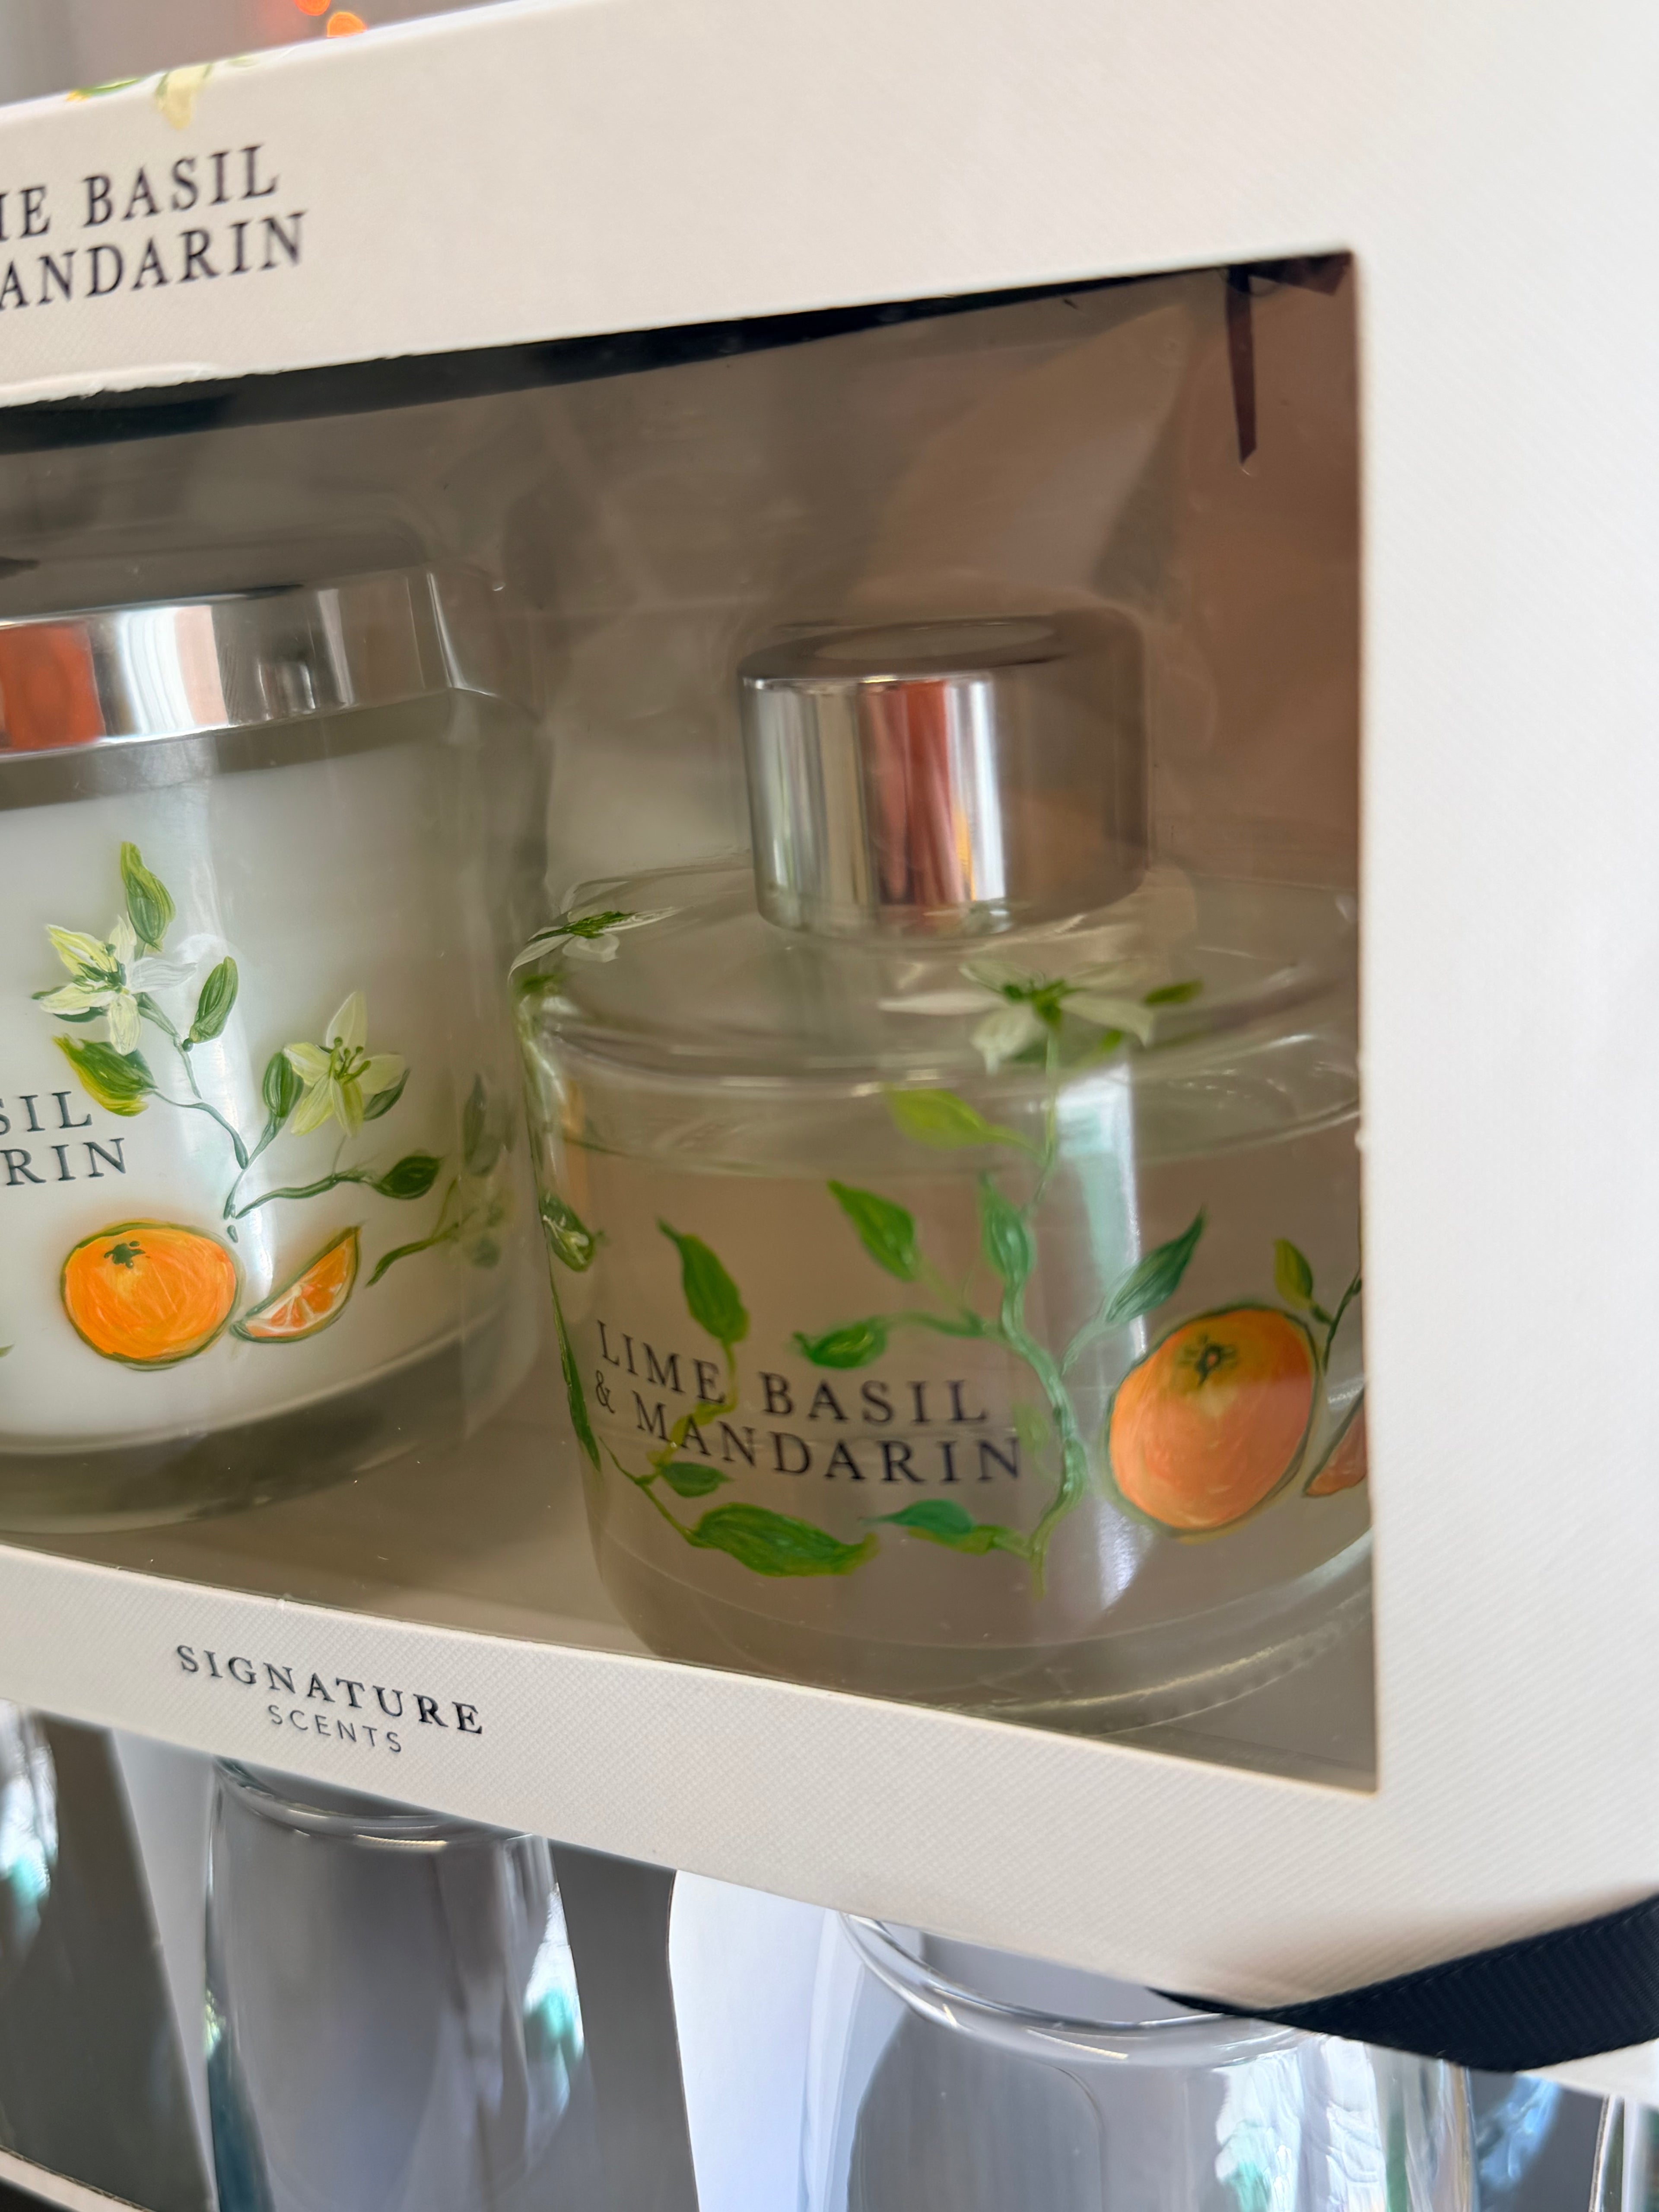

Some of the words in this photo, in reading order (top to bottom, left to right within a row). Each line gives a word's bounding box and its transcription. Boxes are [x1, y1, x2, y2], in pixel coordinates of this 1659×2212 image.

[0, 184, 50, 242] E
[82, 144, 277, 228] BASIL
[0, 210, 305, 311] ANDARIN
[0, 1138, 125, 1185] RIN
[597, 1319, 726, 1404] LIME
[759, 1371, 988, 1423] BASIL
[596, 1370, 616, 1414] &
[632, 1390, 1021, 1485] MANDARIN
[175, 1645, 482, 1735] SIGNATURE
[267, 1705, 401, 1753] SCENTS
